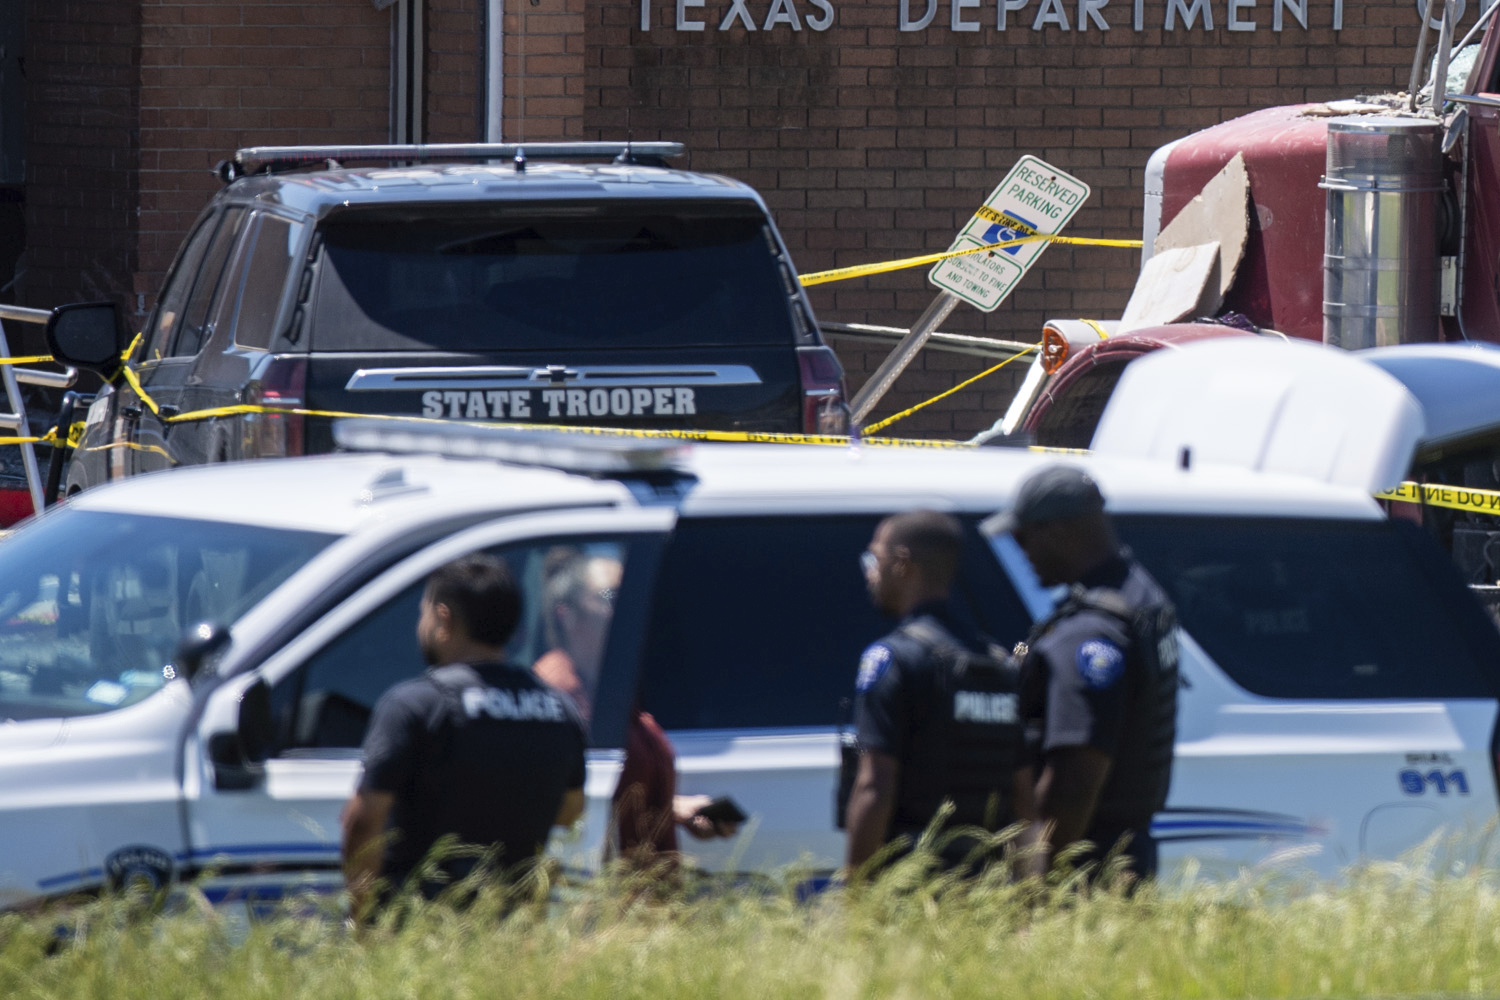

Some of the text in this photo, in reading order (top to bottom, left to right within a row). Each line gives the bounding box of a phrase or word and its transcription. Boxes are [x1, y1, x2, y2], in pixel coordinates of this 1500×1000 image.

[1007, 184, 1063, 219] PARKING
[1016, 166, 1079, 206] RESERVED
[946, 271, 990, 299] AND TOWING
[978, 270, 989, 283] TO
[988, 276, 1007, 292] FINE
[422, 387, 696, 419] STATE TROOPER
[462, 686, 564, 722] POLICE
[1397, 766, 1471, 797] 911
